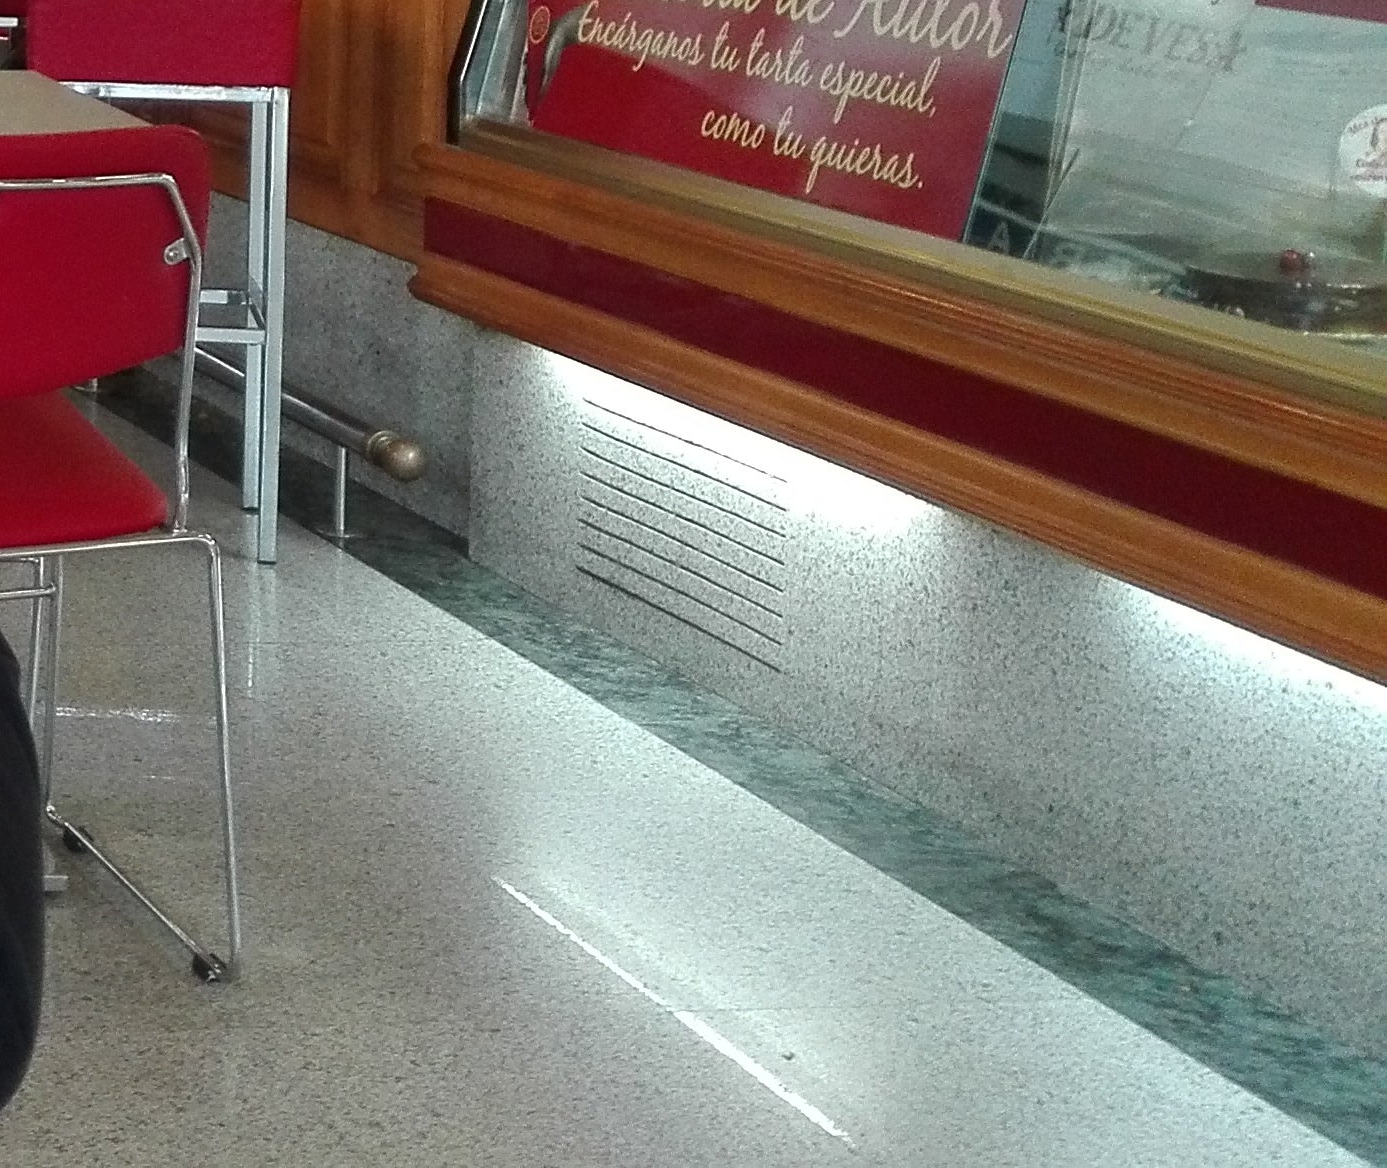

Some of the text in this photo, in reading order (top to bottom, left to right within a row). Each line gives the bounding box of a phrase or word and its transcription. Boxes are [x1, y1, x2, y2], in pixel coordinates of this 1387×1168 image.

[576, 0, 938, 124] Encárganos tu tarta especial,
[701, 105, 924, 196] como tu quieras.
